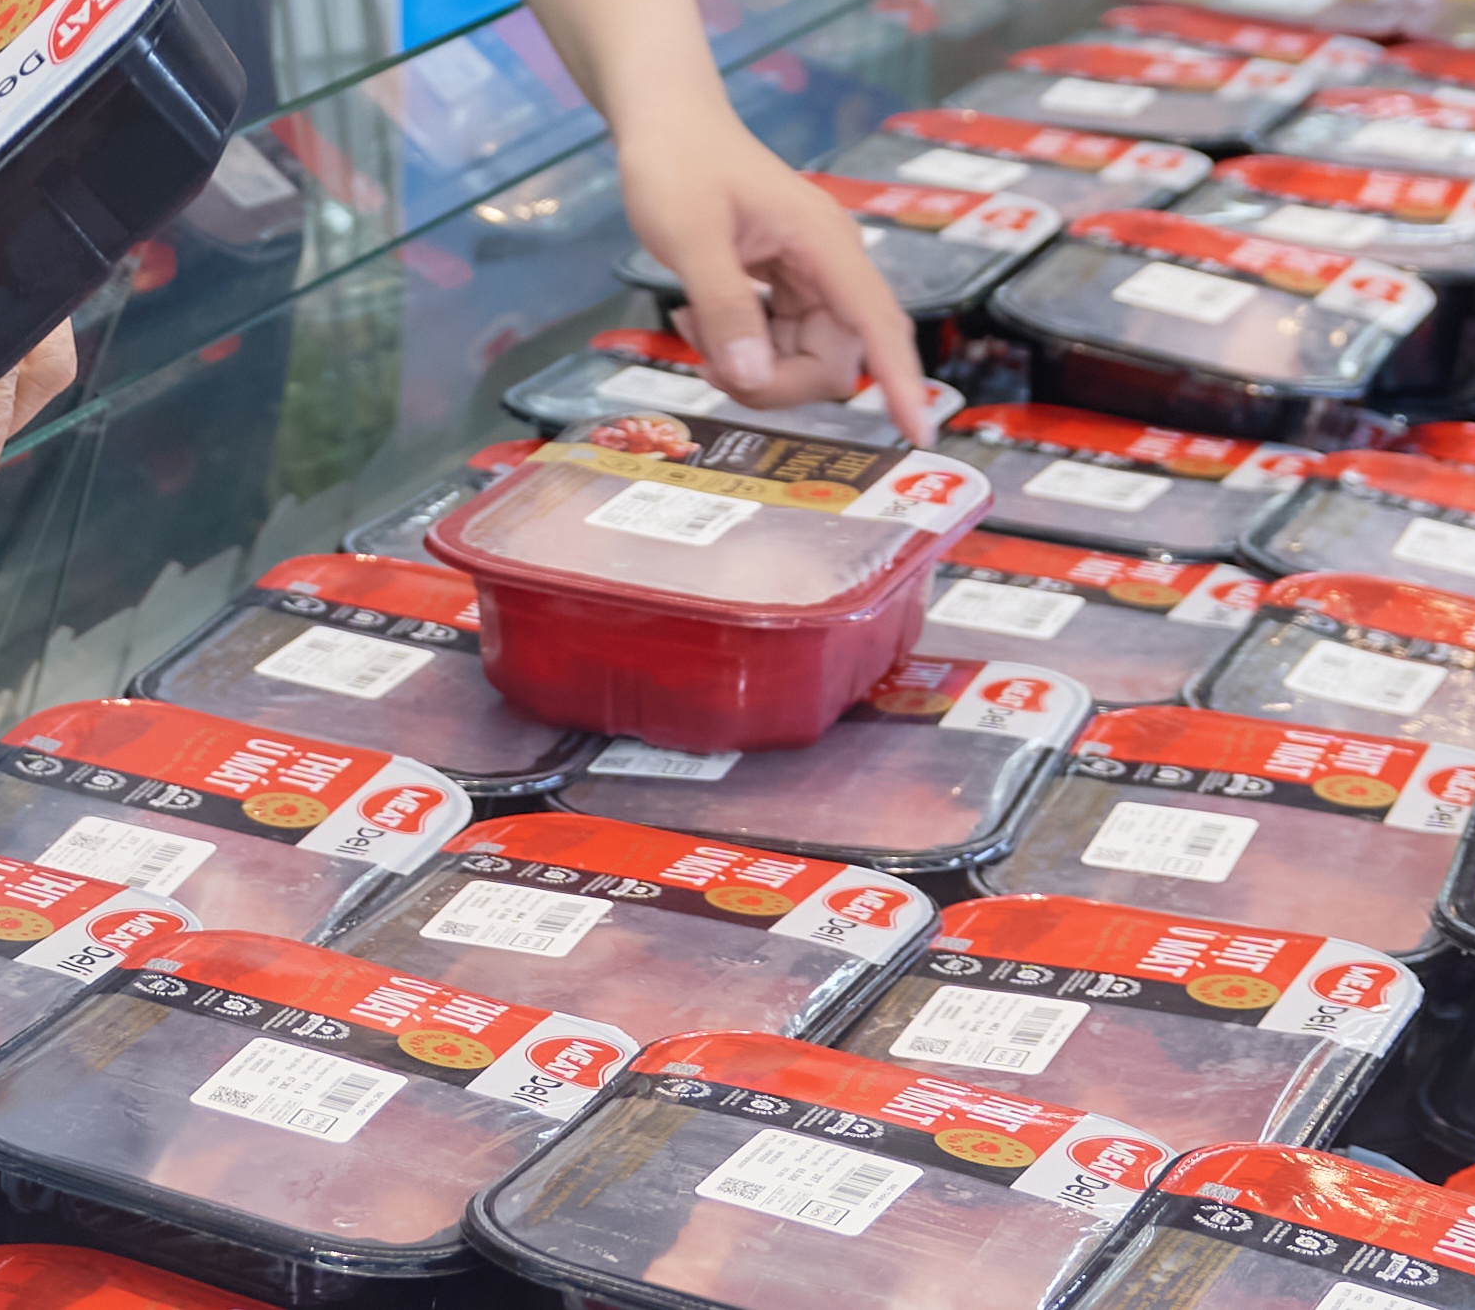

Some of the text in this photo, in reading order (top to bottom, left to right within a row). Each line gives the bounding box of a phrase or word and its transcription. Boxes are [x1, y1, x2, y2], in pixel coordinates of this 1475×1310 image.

[247, 739, 301, 757] Ủ
[1328, 740, 1393, 775] THỊT
[204, 751, 280, 795] MÁT
[278, 752, 353, 792] THỊT
[335, 789, 430, 856] MEAT Deli
[659, 855, 731, 889] MÁT
[694, 846, 754, 863] Ủ
[735, 858, 807, 890] THỊT
[2, 871, 87, 908] THỊT
[810, 888, 890, 946] MEAT Deli
[52, 912, 169, 976] MEAT Deli
[1136, 926, 1231, 978] Ủ MÁT
[1209, 935, 1287, 974] THỊT
[347, 977, 450, 1027] Ủ MÁT
[1329, 965, 1384, 1005] MEAT
[427, 994, 509, 1033] THỊT
[508, 1040, 600, 1107] MEAT Deli
[879, 1086, 955, 1125] MÁT
[961, 1094, 1041, 1133] THỊT
[1055, 1140, 1145, 1209] MEAT Deli
